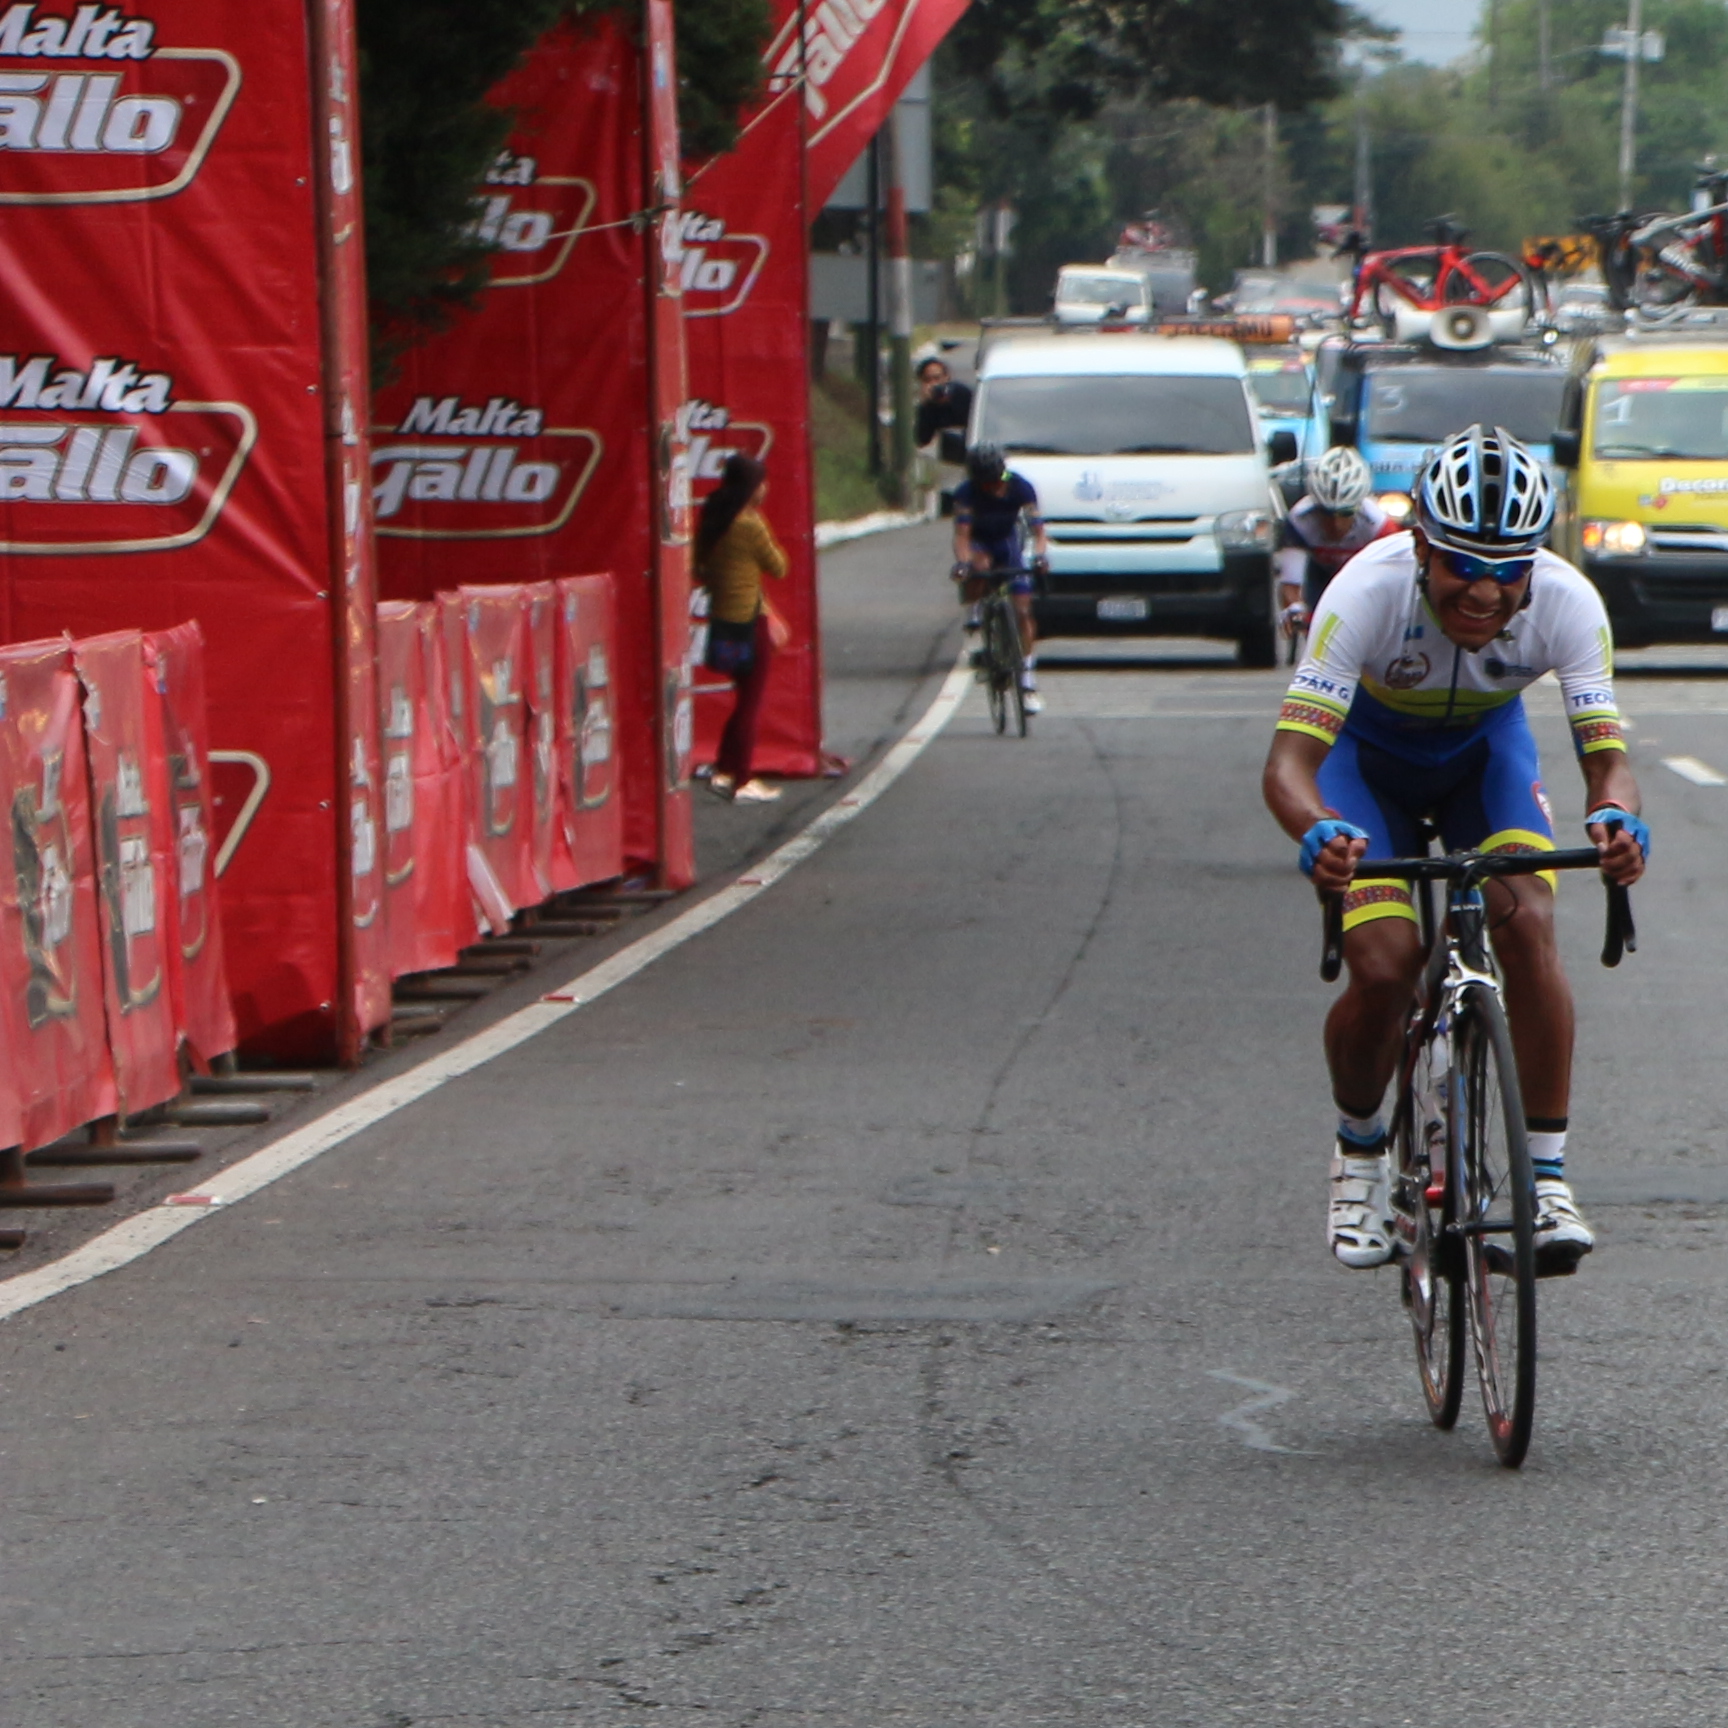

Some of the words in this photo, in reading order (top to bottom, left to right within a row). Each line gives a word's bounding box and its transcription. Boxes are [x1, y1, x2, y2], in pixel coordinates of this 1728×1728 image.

[401, 396, 545, 437] Malta
[0, 423, 200, 504] allo
[370, 445, 561, 519] Gallo
